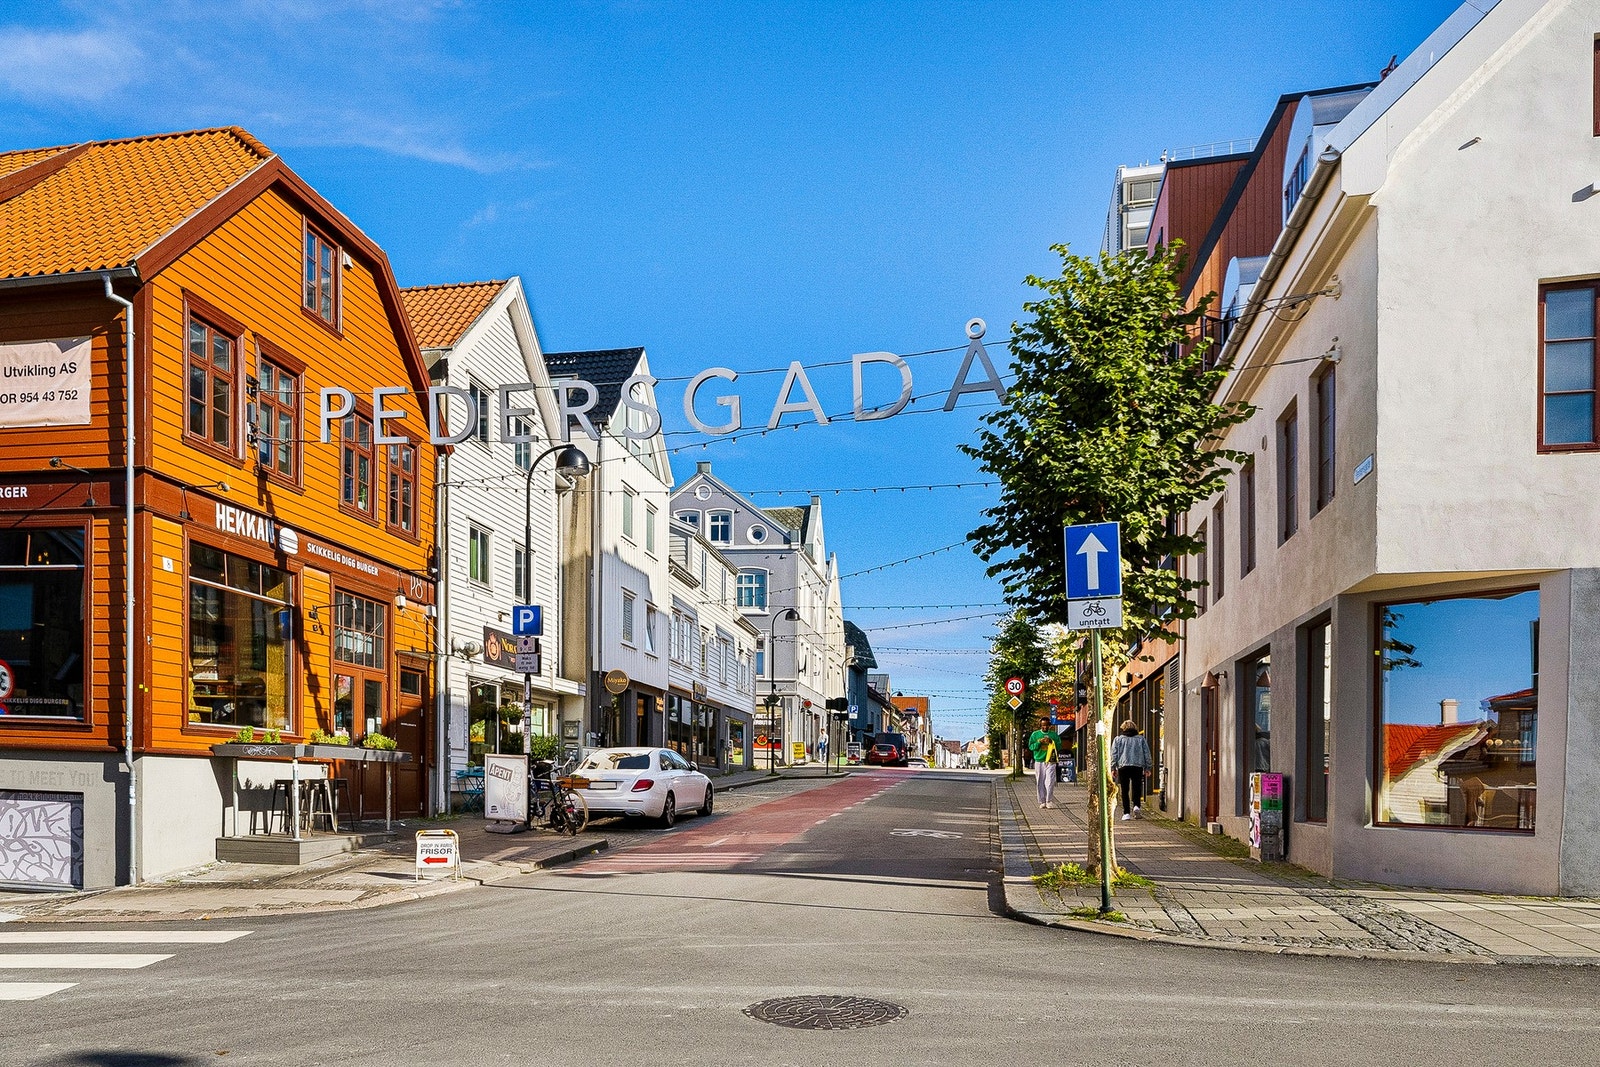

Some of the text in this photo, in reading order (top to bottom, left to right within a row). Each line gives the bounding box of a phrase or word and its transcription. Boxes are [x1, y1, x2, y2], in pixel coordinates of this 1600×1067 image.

[3, 361, 77, 378] Utvikling AS
[319, 317, 1008, 446] PEDERSGADÅ
[19, 392, 39, 403] 954
[42, 390, 55, 402] 43
[58, 389, 78, 401] 752
[215, 502, 275, 544] HEKKAN
[306, 542, 379, 577] SKIKKELIG DIGG BURGER
[519, 609, 534, 631] P
[1079, 618, 1111, 627] unntatt
[1009, 682, 1021, 691] 30
